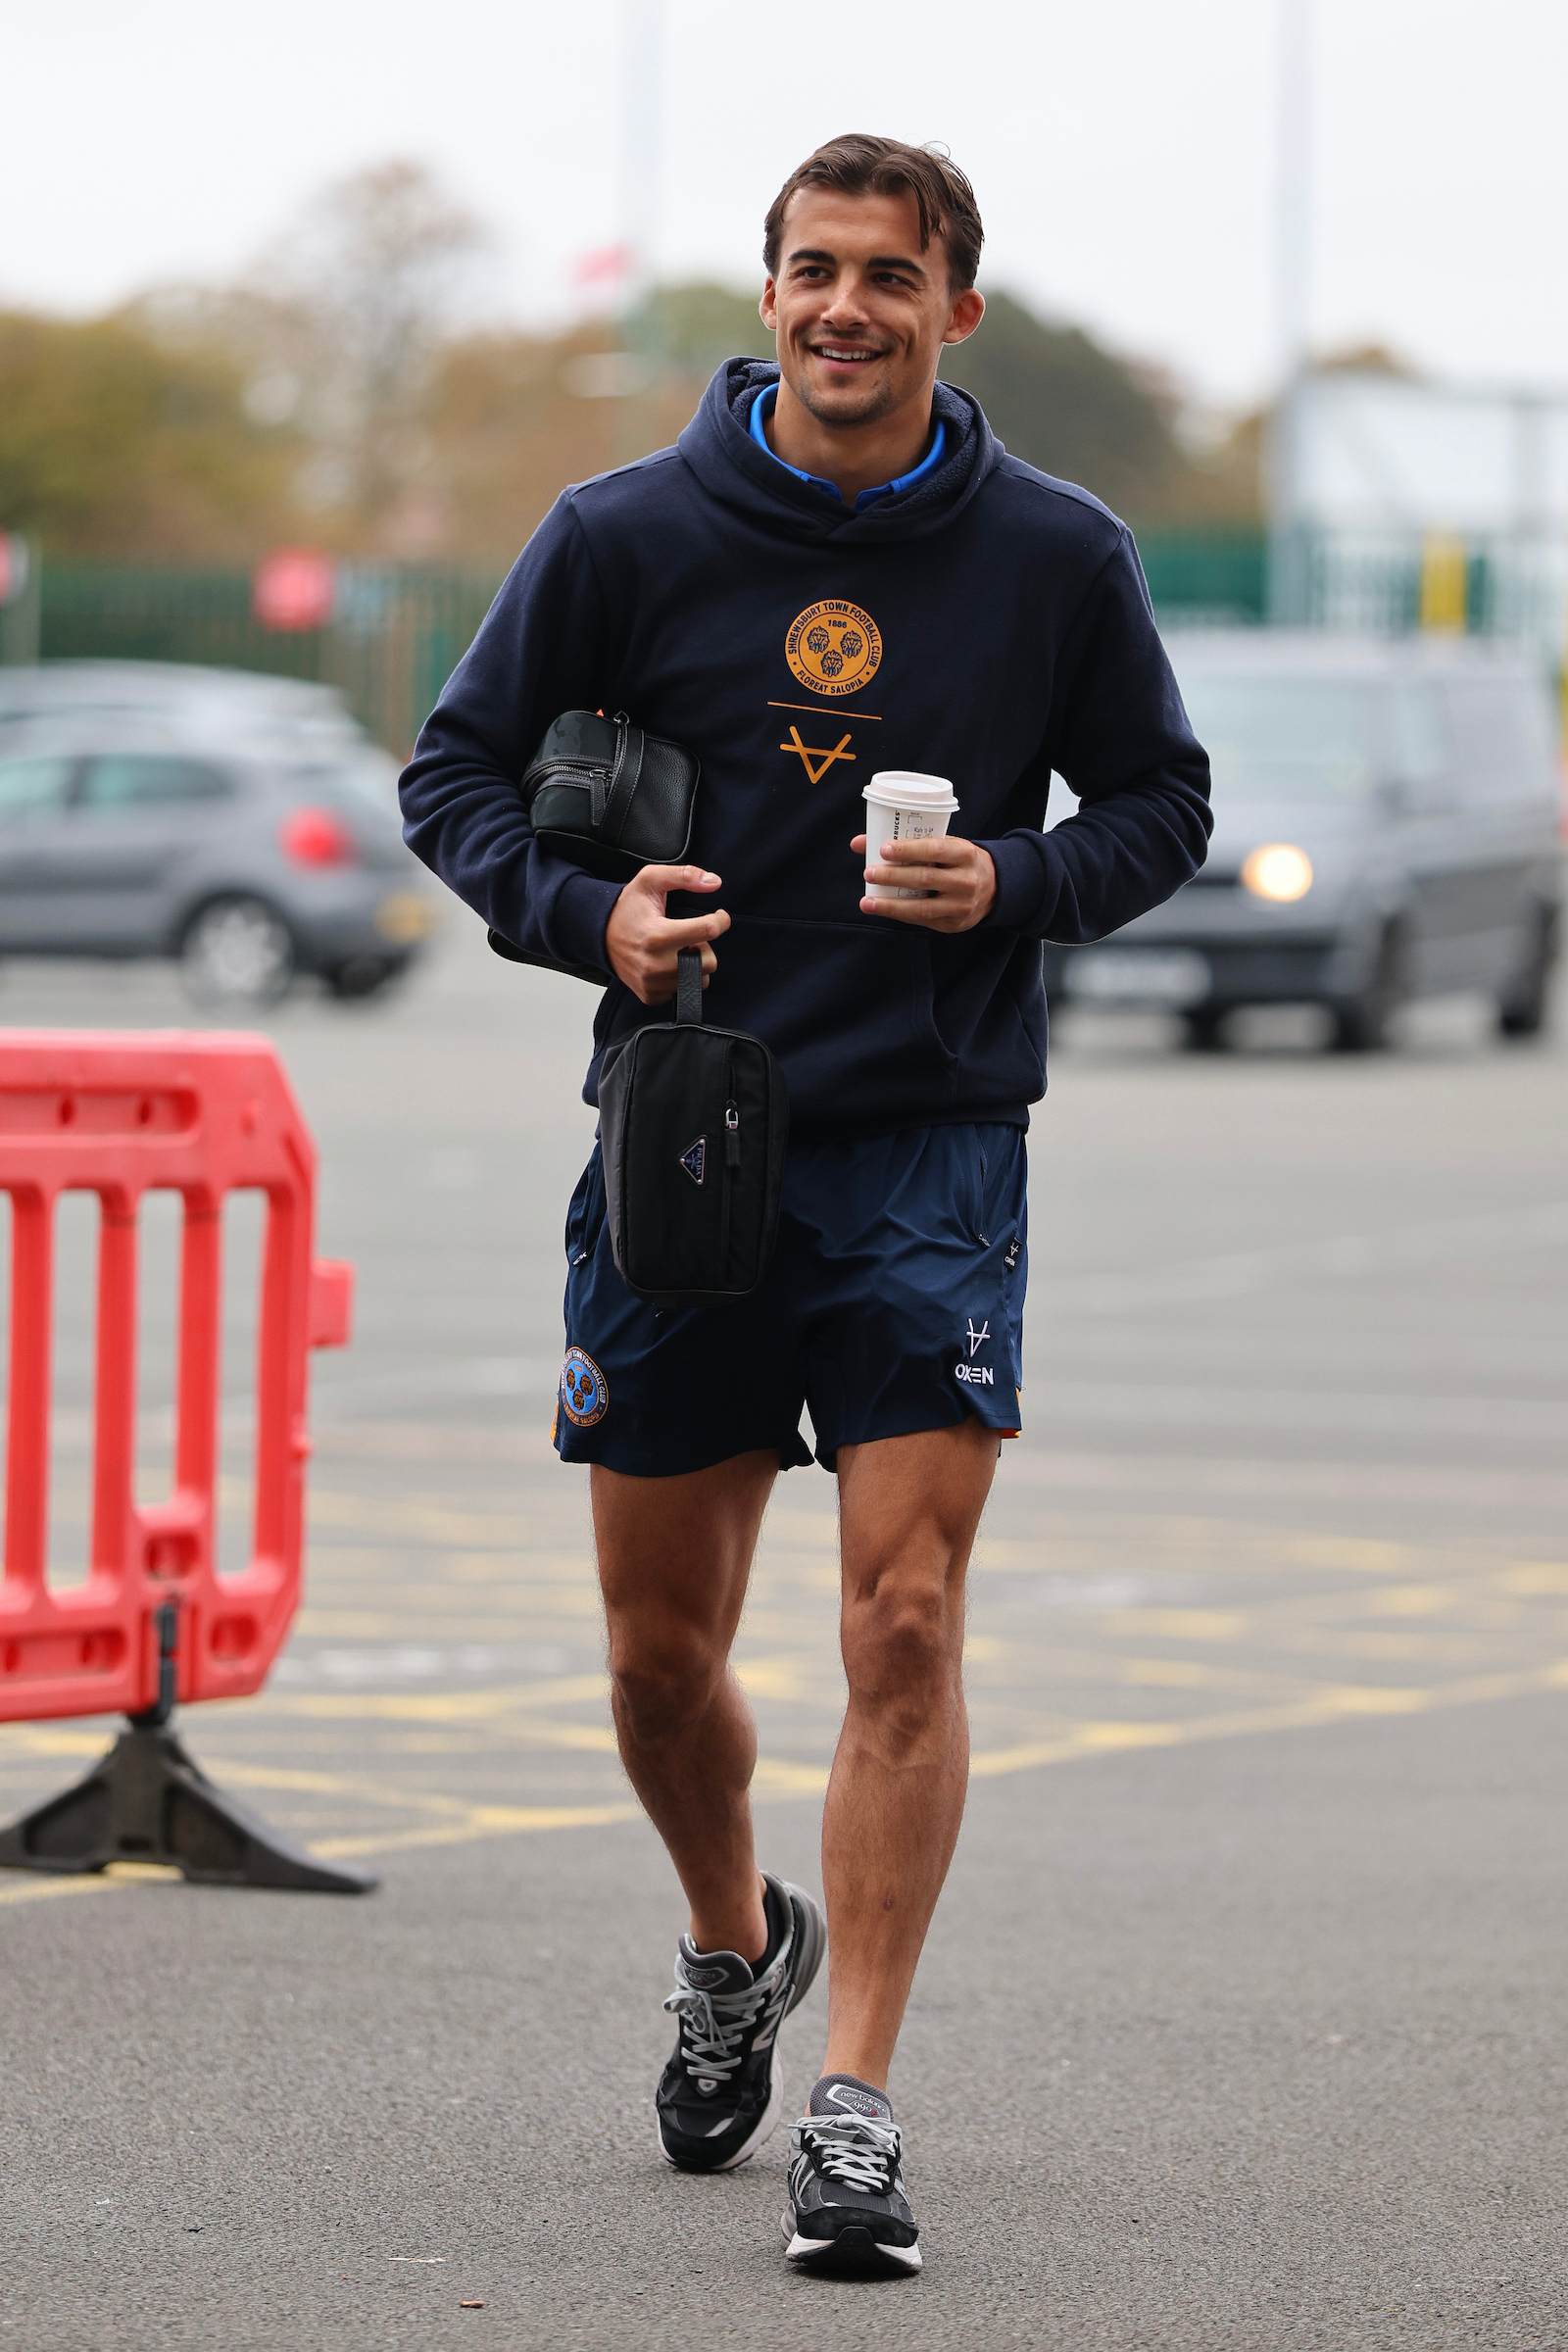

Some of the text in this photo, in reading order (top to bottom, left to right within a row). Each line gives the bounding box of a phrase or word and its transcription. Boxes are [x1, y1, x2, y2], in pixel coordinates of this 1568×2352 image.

[788, 602, 880, 667] SHREWSBURY TOWN FOOTBALL CLUB
[827, 619, 848, 628] 1886
[797, 669, 863, 694] FLOREAT SALOPIA
[581, 1355, 604, 1386] FOOTBALL
[955, 1363, 995, 1385] OXEN
[854, 2101, 872, 2113] 990
